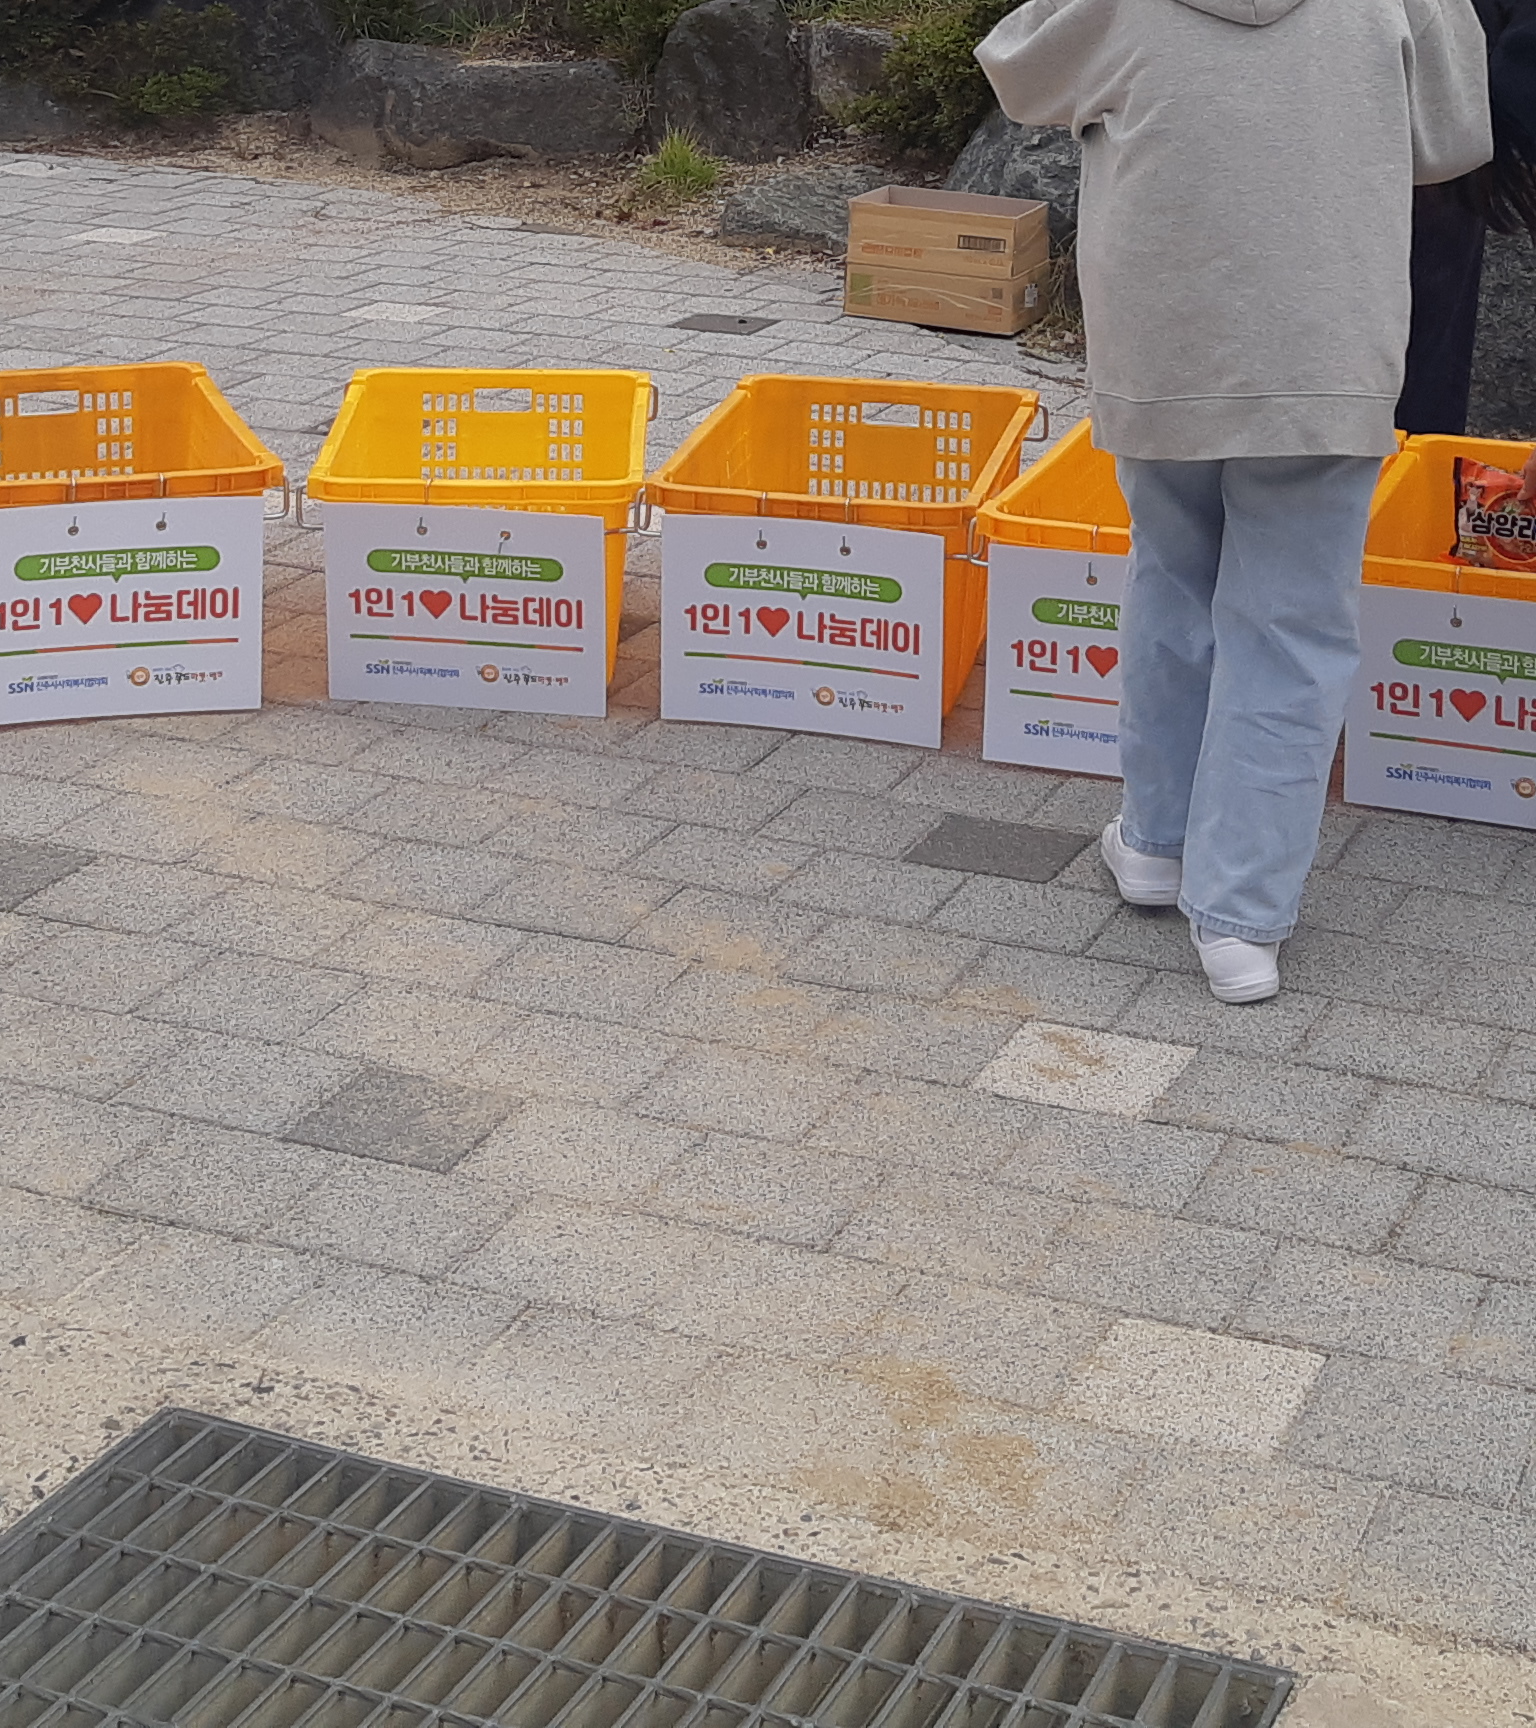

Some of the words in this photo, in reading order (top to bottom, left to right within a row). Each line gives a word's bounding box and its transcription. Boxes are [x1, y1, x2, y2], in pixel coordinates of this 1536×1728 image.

[39, 552, 133, 575] 기부천사들과
[135, 550, 198, 570] 함께하는
[391, 552, 480, 575] 기부천사들과
[482, 557, 542, 578] 함께하는
[729, 567, 819, 591] 기부천사들과
[821, 573, 880, 599] 함께하는
[110, 586, 240, 623] 나눔데이
[348, 587, 394, 618] 1인
[459, 592, 583, 629] 나눔데이
[684, 603, 731, 635] 1인
[797, 610, 920, 656] 나눔데이
[365, 663, 390, 675] SSN
[1010, 639, 1058, 674] 1인
[1419, 644, 1520, 674] 기부천사들과
[8, 681, 34, 695] SSN
[698, 682, 724, 695] SSN
[1370, 681, 1420, 718] 1인
[1024, 723, 1050, 736] SSN
[1386, 766, 1413, 781] SSN
